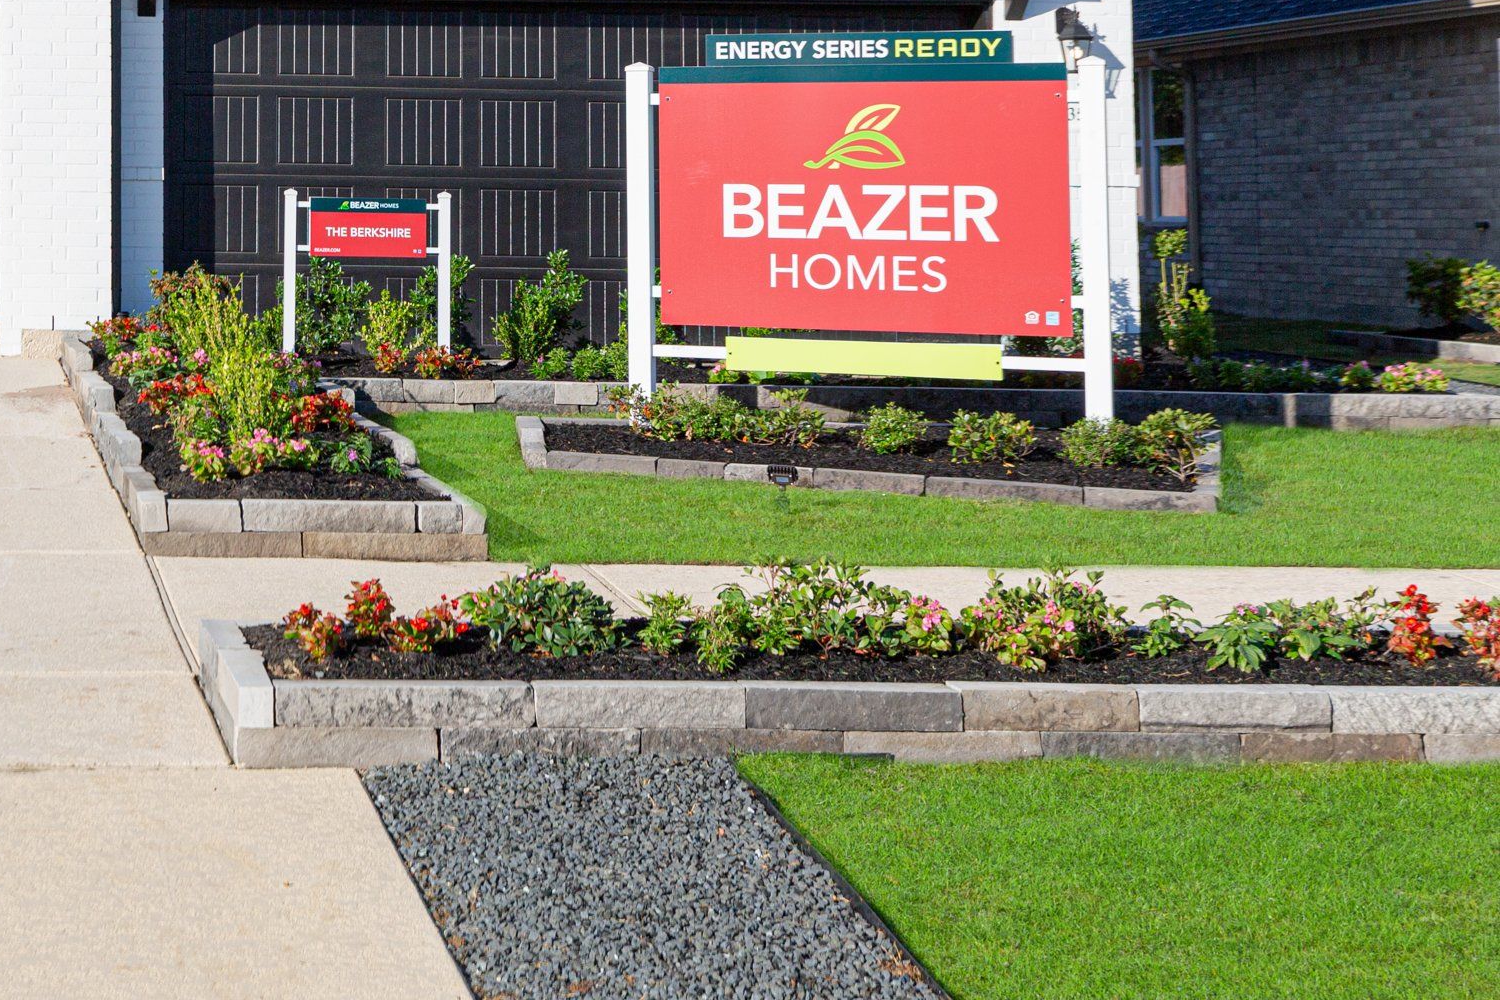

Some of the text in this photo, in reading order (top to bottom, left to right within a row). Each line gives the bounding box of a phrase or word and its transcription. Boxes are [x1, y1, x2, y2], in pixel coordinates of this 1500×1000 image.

[715, 37, 1003, 61] ENERGY SERIES READY
[350, 201, 379, 209] BEAZER
[722, 183, 1000, 243] BEAZER
[325, 226, 411, 238] THE BERKSHIRE
[769, 252, 948, 293] HOMES
